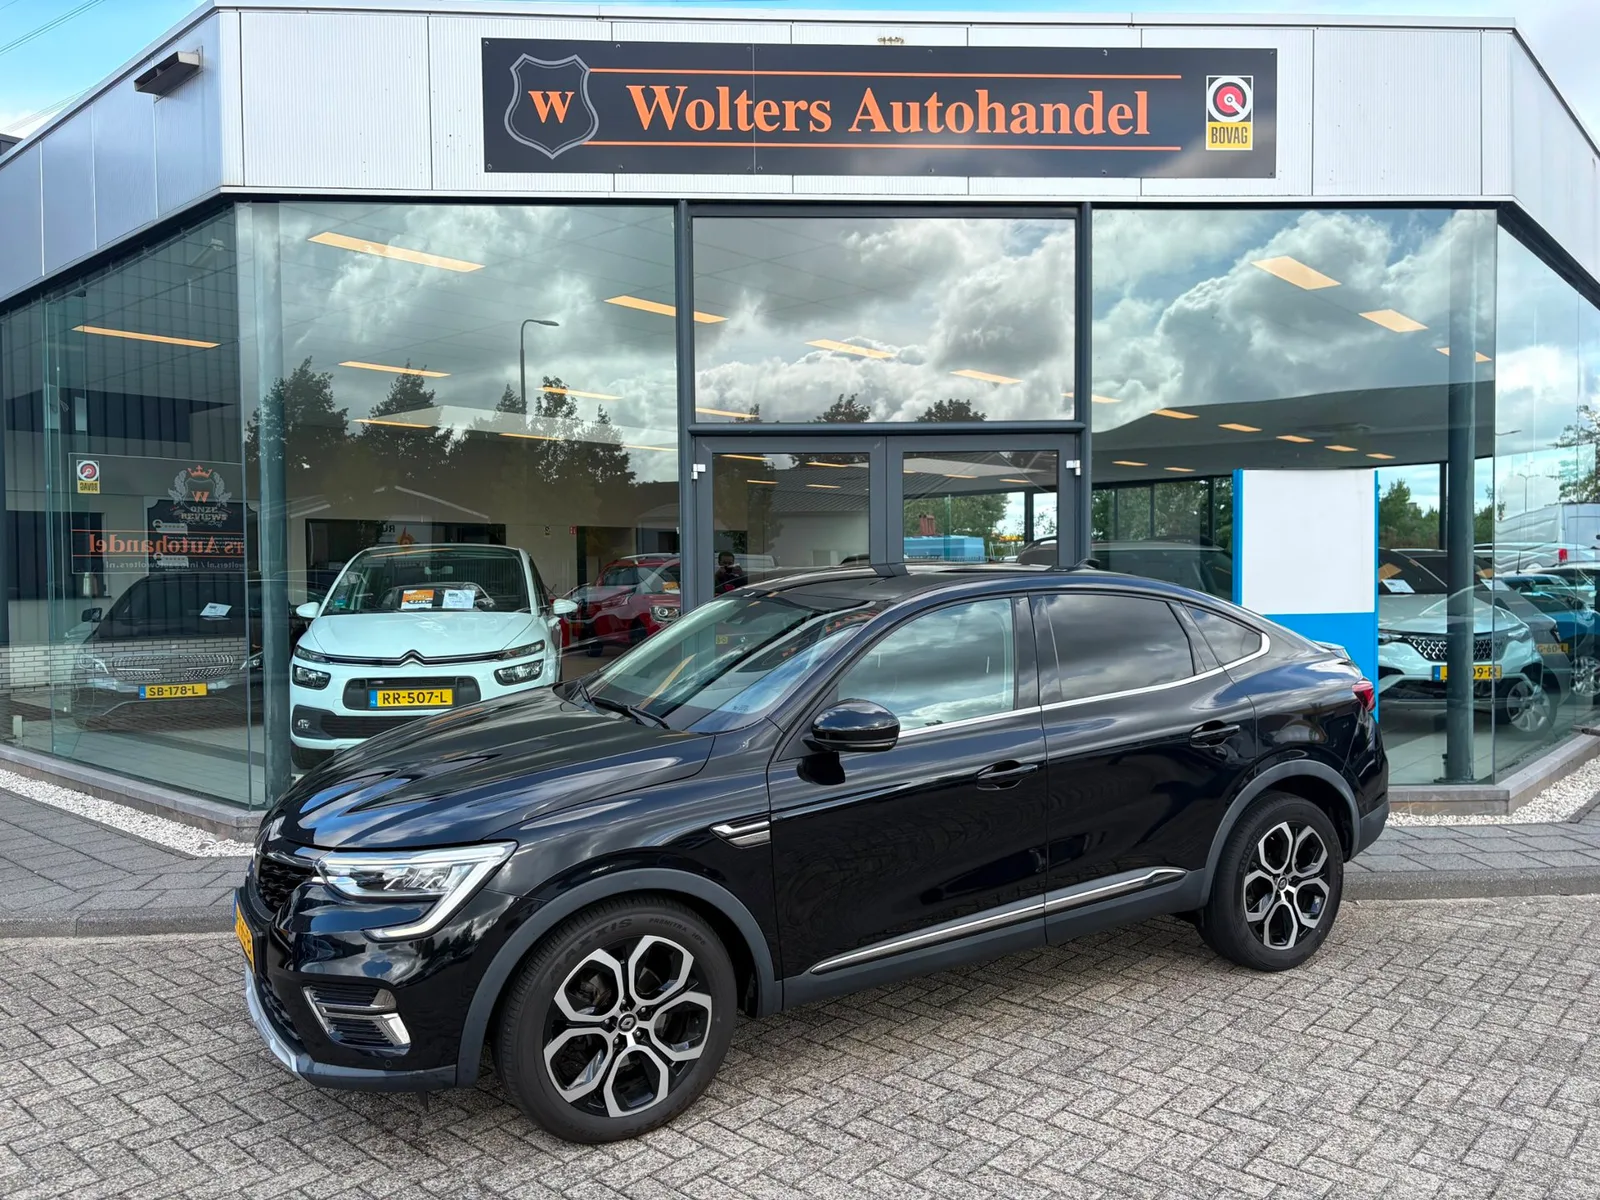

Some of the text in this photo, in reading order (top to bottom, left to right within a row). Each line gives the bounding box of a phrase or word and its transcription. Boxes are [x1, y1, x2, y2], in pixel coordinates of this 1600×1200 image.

[528, 90, 575, 124] W
[626, 85, 1150, 136] Wolters Autohandel
[1211, 126, 1248, 145] BOVAG
[191, 490, 210, 504] W
[180, 512, 229, 521] REVIEWS
[149, 686, 199, 696] SB-178-L
[382, 691, 447, 705] RR-507-L
